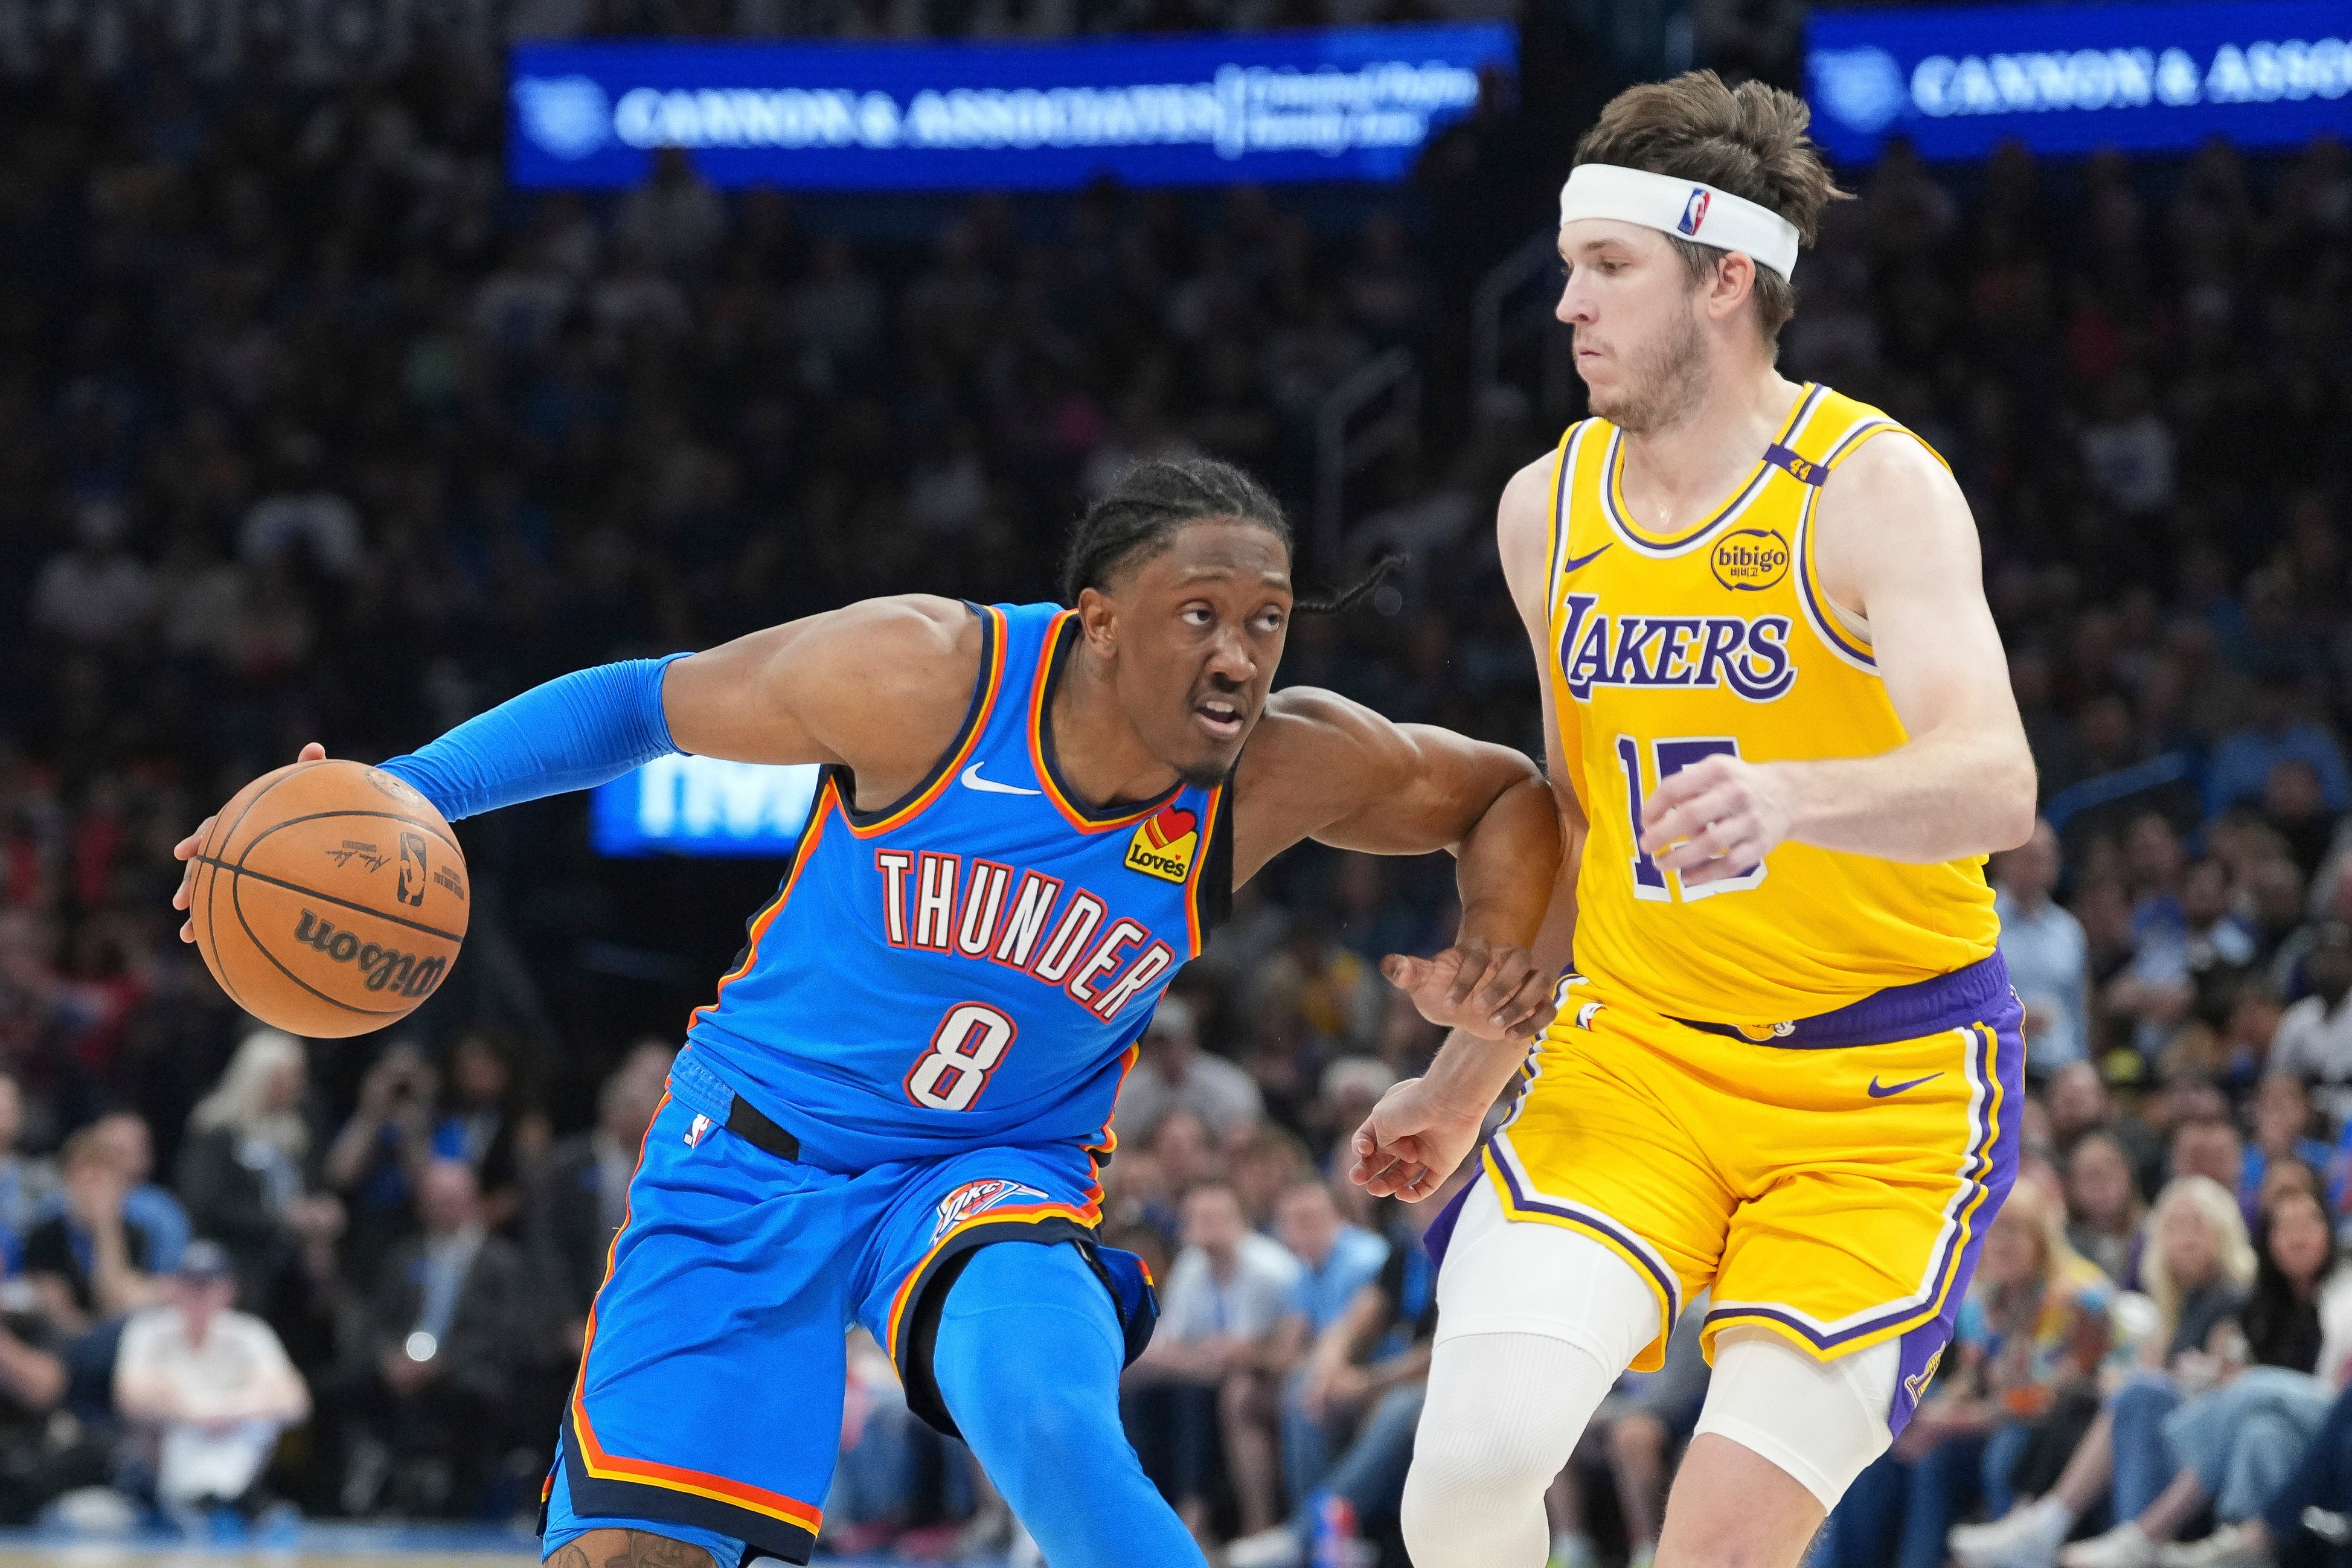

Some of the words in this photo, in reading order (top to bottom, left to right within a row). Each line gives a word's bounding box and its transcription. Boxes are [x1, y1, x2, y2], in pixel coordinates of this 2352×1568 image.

[1790, 458, 1812, 481] 44
[1719, 545, 1786, 572] bibigo
[1731, 567, 1758, 577] 비비고
[1559, 592, 1798, 703] LAKERS
[293, 907, 447, 997] Wilson
[876, 848, 1175, 1024] THUNDER
[905, 1001, 1018, 1112] 8
